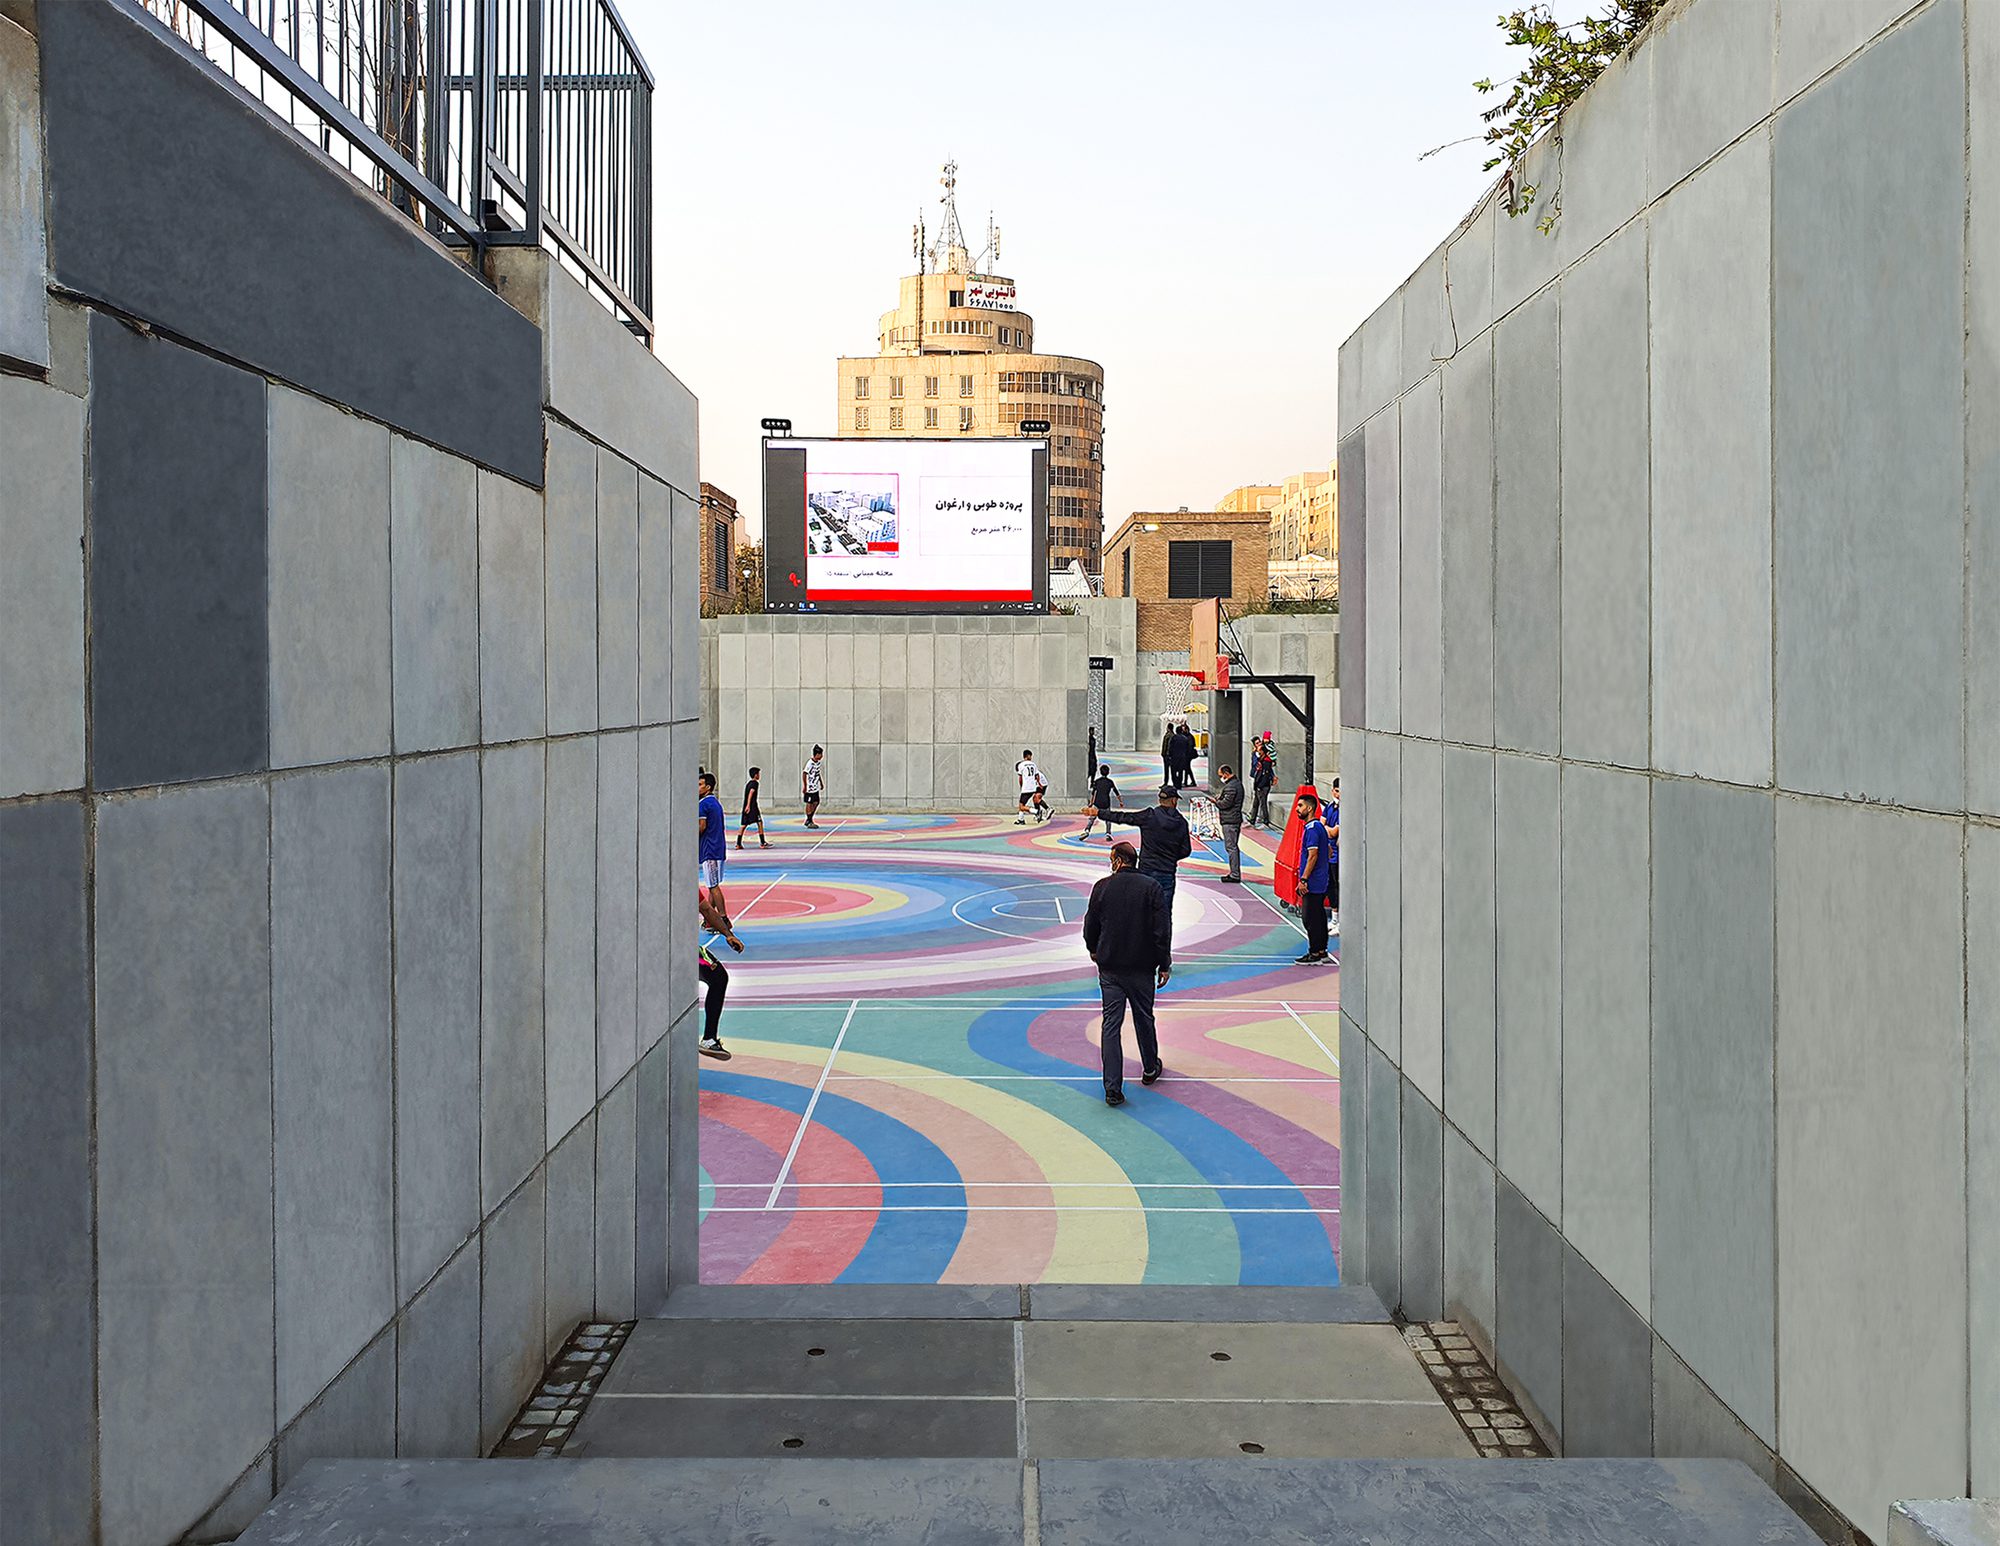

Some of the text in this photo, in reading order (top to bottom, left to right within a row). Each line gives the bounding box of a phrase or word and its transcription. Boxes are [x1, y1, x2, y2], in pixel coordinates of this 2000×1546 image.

[968, 284, 983, 297] شهر
[935, 498, 1023, 513] پروژه طوبی و ارغوان
